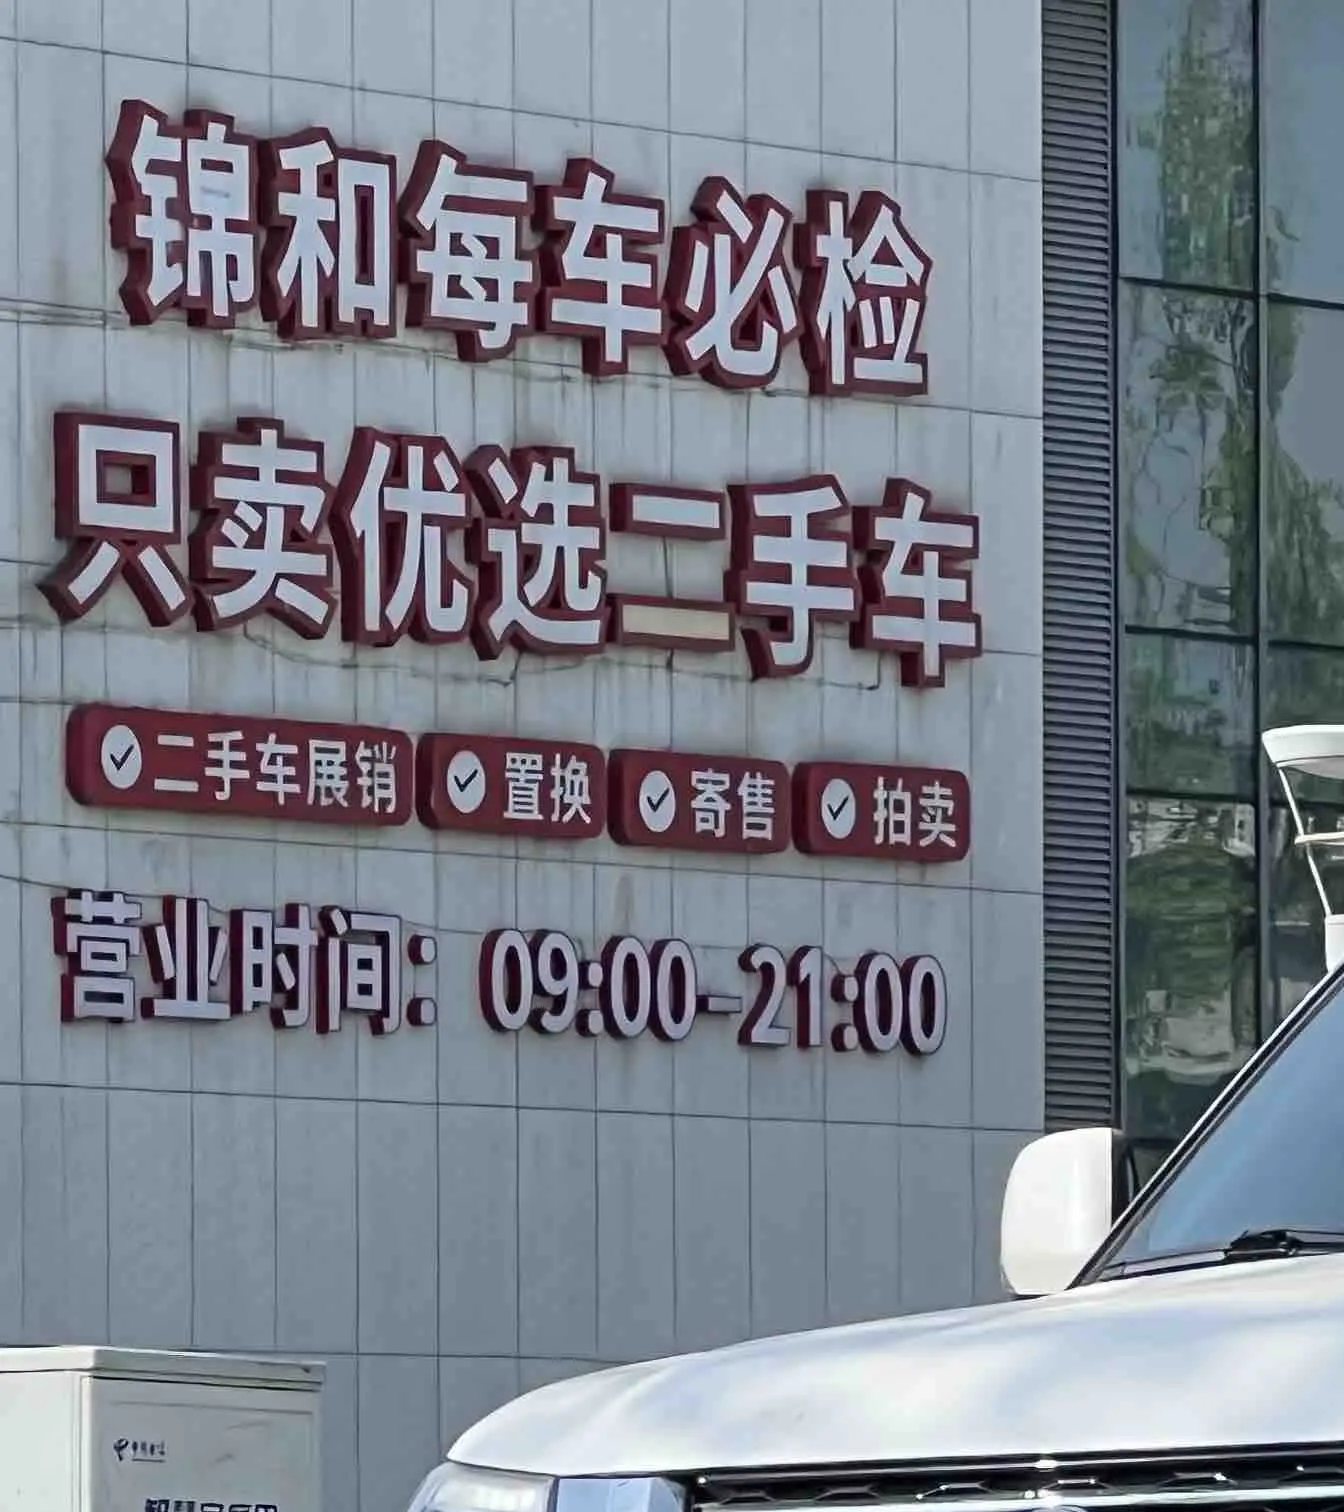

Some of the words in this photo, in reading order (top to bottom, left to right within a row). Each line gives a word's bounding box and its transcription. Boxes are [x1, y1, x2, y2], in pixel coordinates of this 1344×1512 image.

[106, 98, 930, 396] 锦和每车必检
[42, 410, 982, 690] 只卖优选二手车
[152, 731, 400, 816] 二手车展销
[502, 751, 594, 826] 置换
[689, 768, 777, 841] 寄售
[871, 776, 957, 847] 拍卖
[479, 927, 947, 1057] 09:00-21:00
